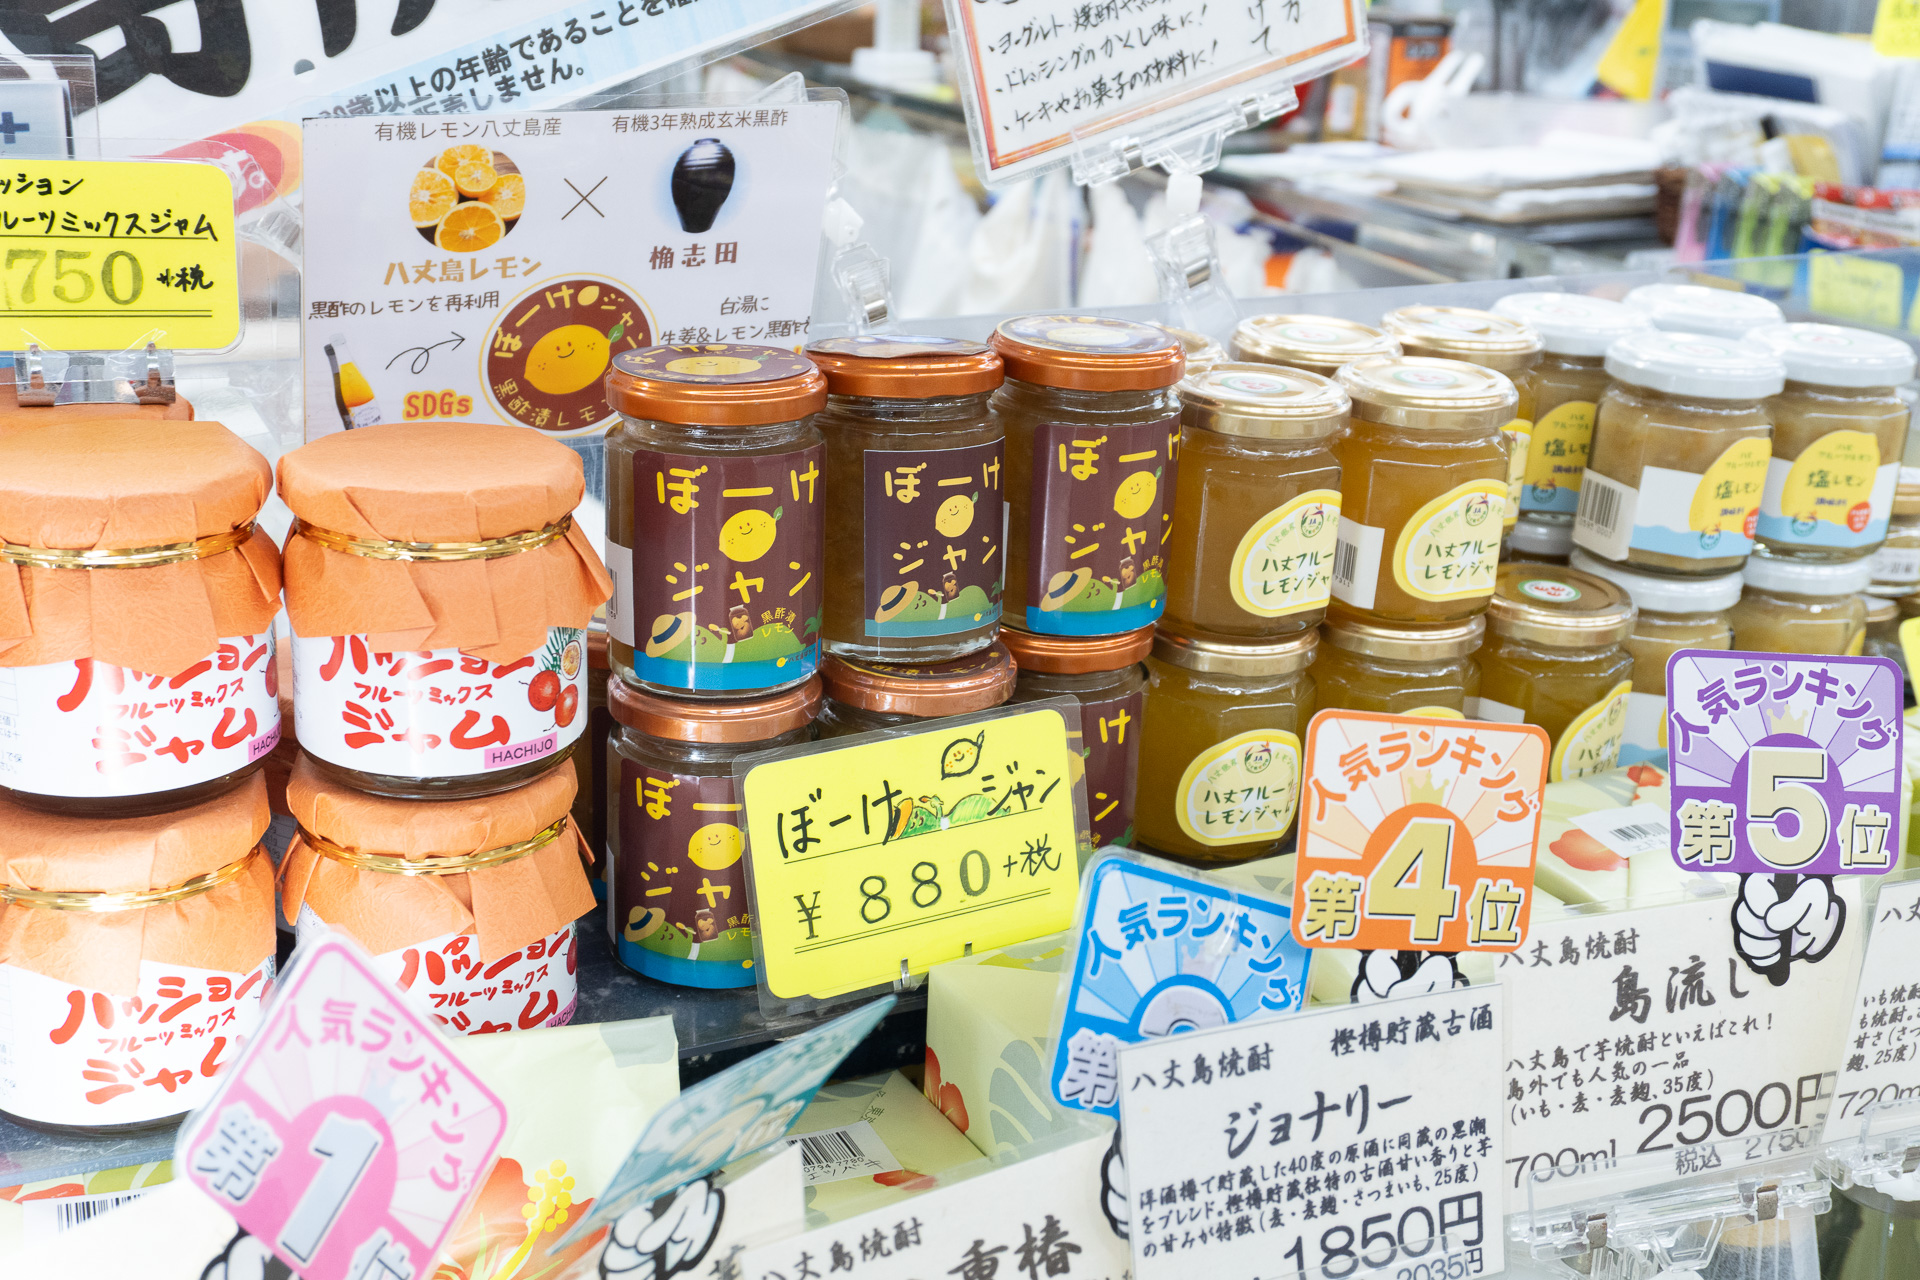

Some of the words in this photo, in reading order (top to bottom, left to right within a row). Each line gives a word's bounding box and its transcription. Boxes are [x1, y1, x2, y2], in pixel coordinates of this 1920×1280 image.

[374, 117, 562, 142] 有機レモン八丈島産
[611, 108, 788, 133] 有機3年熟成玄米黒酢
[383, 255, 542, 286] 八丈島レモン
[308, 290, 500, 320] 黒酢のレモンを再利用
[720, 295, 769, 316] 白湯に
[403, 387, 471, 421] SDGs
[494, 377, 614, 427] 黒酢漬レモ
[656, 460, 820, 515] ぼーけ
[885, 456, 1001, 504] ぼーけ
[1715, 480, 1762, 500] 塩レモン
[1807, 469, 1867, 488] 塩レモン
[893, 536, 997, 574] ジャン
[1064, 513, 1173, 559] ジャン
[665, 560, 812, 604] ジャン
[761, 622, 795, 638] レモン
[342, 700, 511, 754] ジャム
[1673, 665, 1899, 753] 人気ランキング
[491, 738, 554, 764] HACHIJO
[1312, 730, 1541, 822] 人気ランキング
[777, 779, 903, 859] ぼーけ
[1089, 896, 1299, 1010] 人気ランキング
[1500, 928, 1641, 968] 八丈島焼酎
[429, 963, 549, 1009] フルーツミックス
[1609, 954, 1750, 1024] 島流し
[98, 1006, 236, 1053] フルーツミックス
[1131, 1041, 1274, 1092] 八丈島焼酎
[1330, 1003, 1493, 1057] 樫樽貯蔵古酒
[1505, 1012, 1773, 1073] 八丈島で芋焼酎といえばこれ!
[274, 997, 468, 1193] 人気ランキング
[1506, 1050, 1690, 1101] 島外でも人気の一品
[1223, 1084, 1413, 1160] ジョナリー
[1675, 1144, 1722, 1176] 税込
